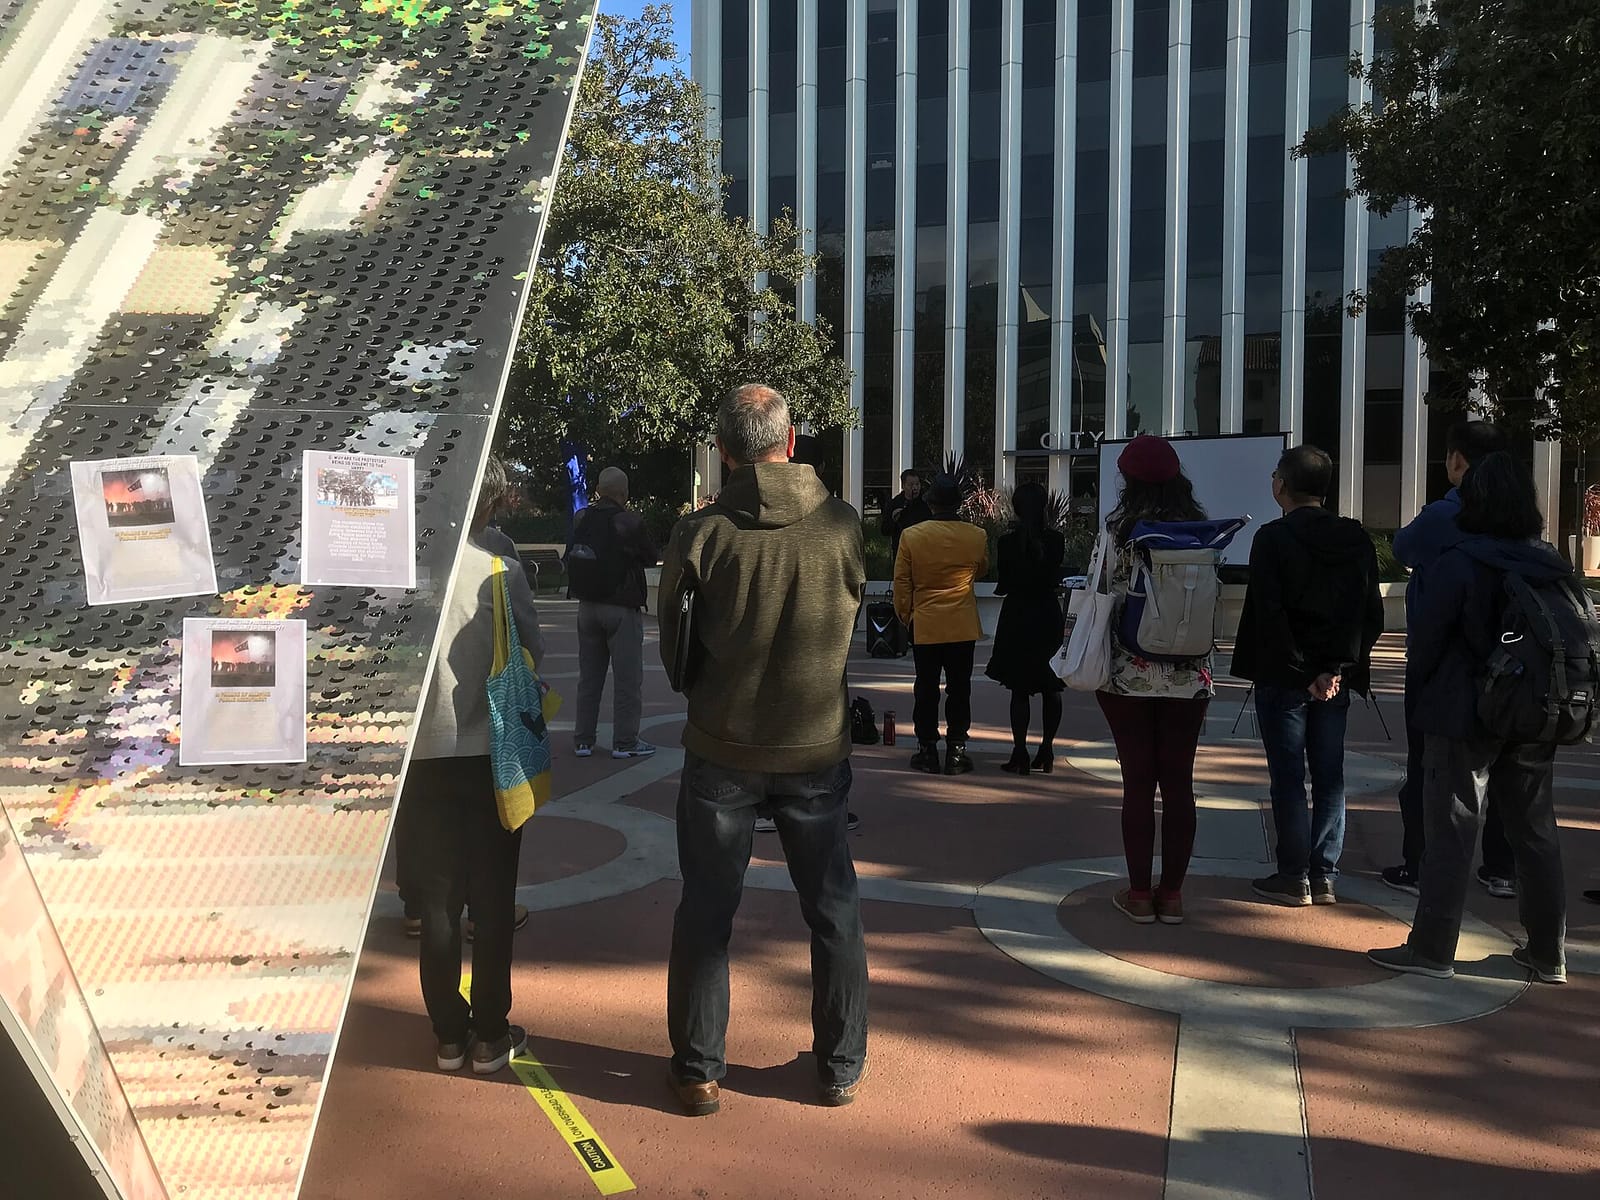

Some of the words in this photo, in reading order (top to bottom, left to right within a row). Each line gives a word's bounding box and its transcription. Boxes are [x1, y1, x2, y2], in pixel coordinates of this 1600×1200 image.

[1040, 431, 1104, 449] CITY
[549, 1098, 575, 1126] OVERHEAD
[569, 1126, 585, 1139] LOW
[580, 1142, 606, 1169] CAUTION
